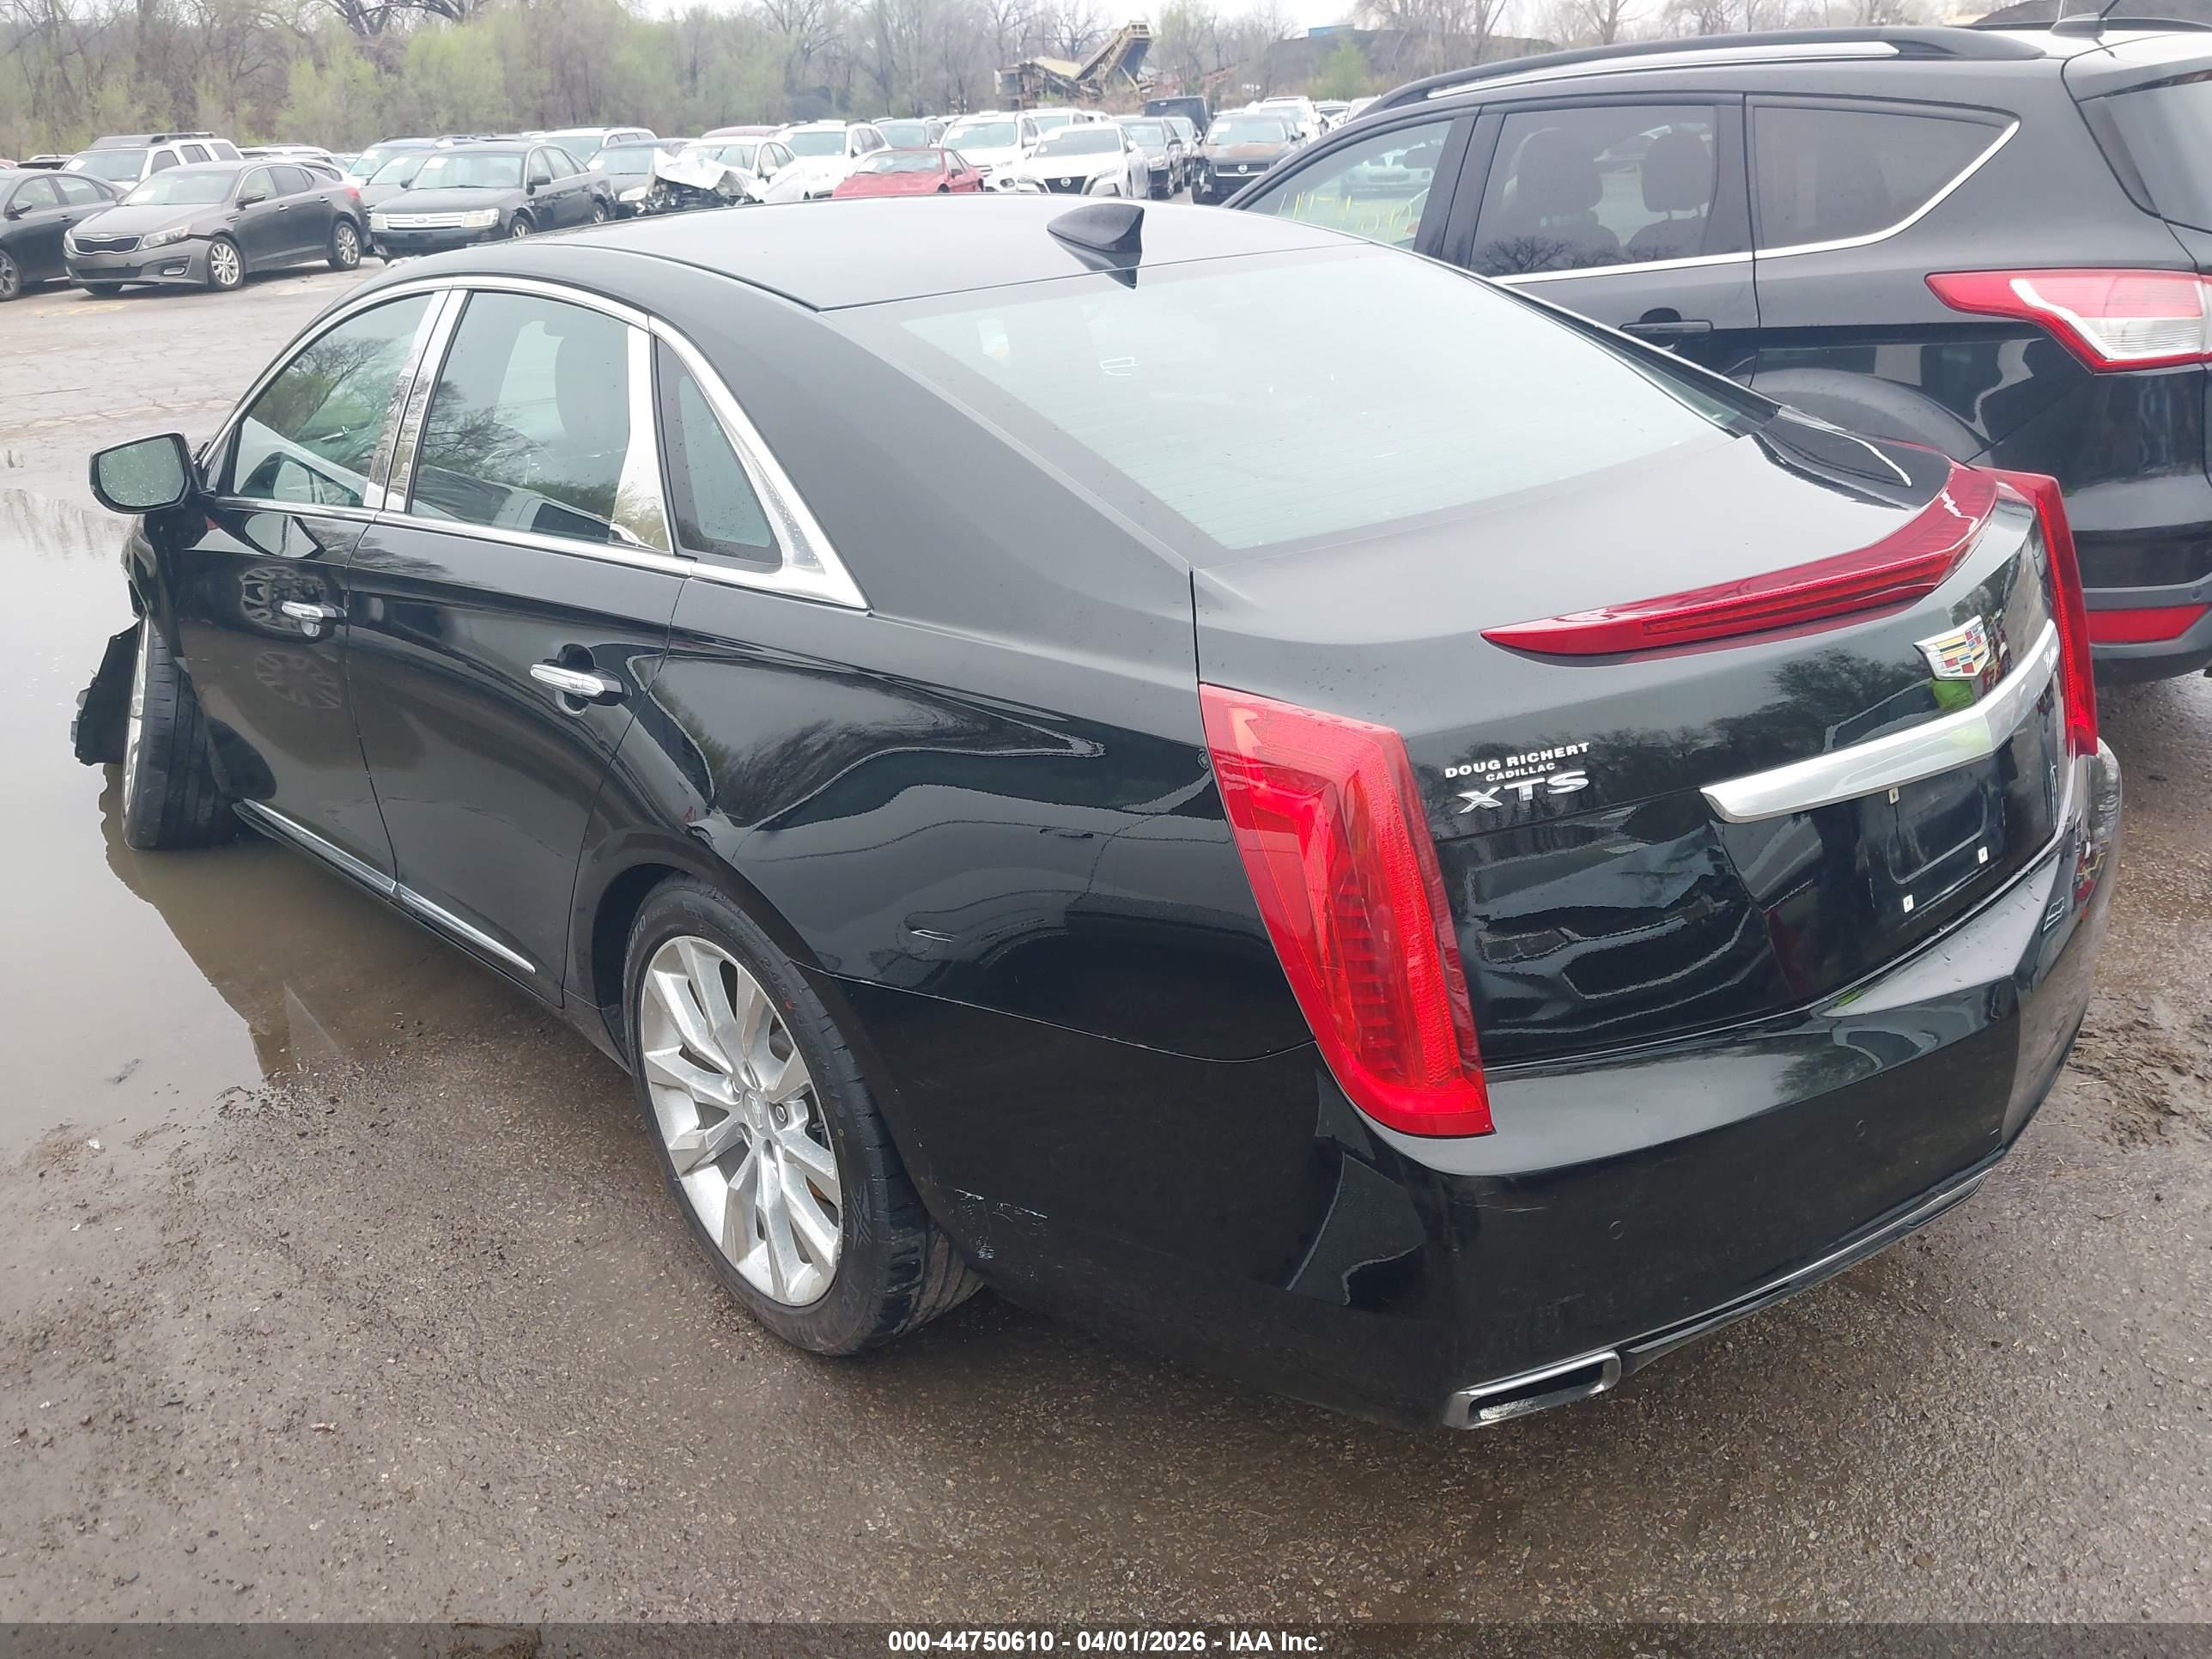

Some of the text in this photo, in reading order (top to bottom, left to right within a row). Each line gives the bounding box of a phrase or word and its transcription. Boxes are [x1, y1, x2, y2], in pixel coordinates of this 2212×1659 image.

[1444, 742, 1589, 779] DOUG RICHERT
[1486, 763, 1556, 782] CADILLAC
[1456, 770, 1589, 814] XTS
